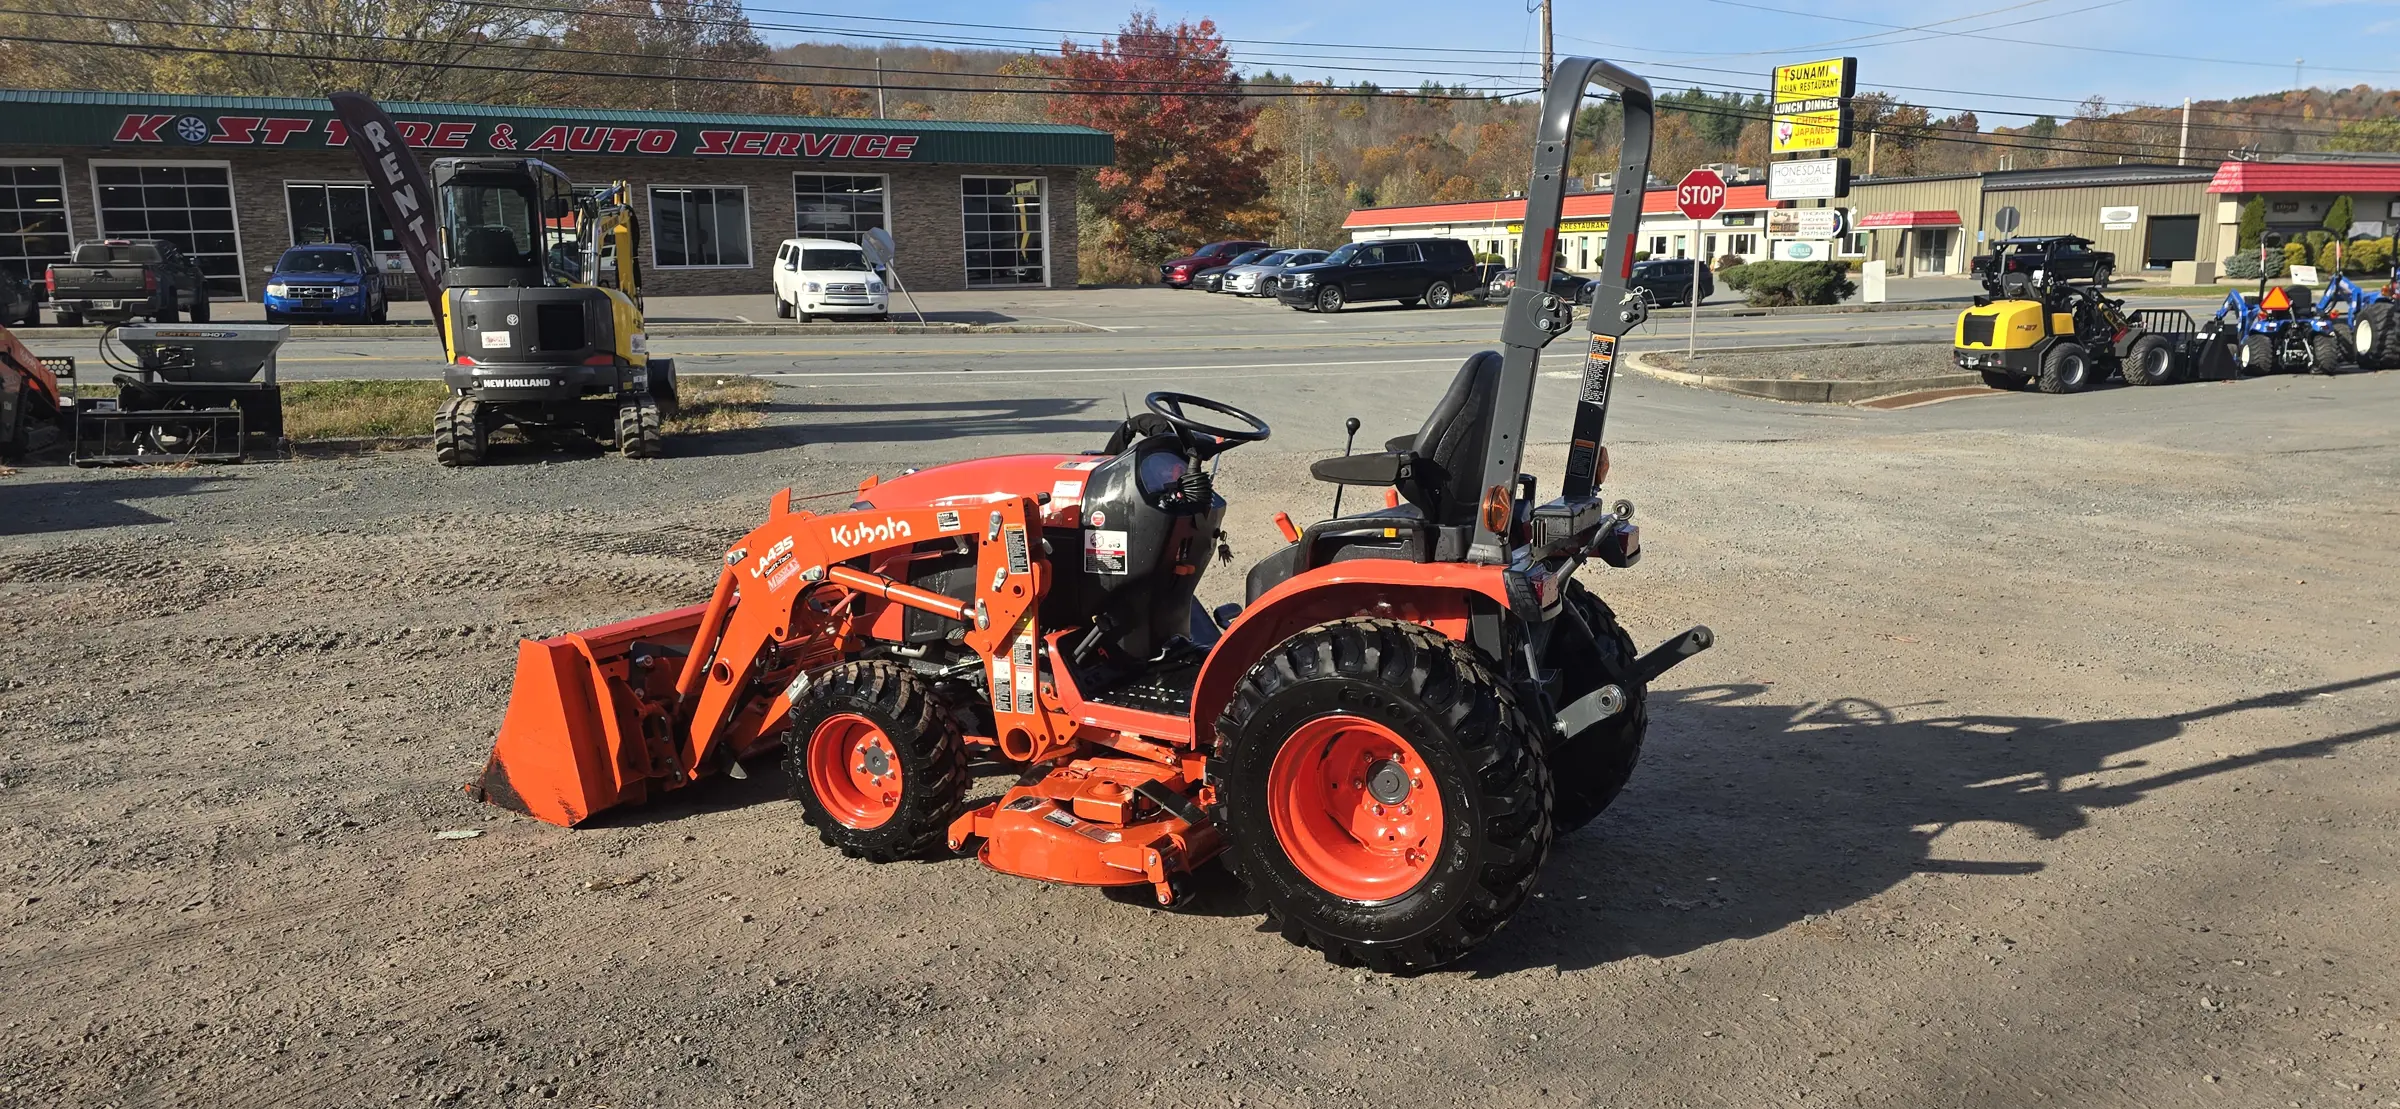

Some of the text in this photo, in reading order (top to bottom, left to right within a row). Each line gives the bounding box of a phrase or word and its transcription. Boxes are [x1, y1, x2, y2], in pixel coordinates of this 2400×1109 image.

[1784, 65, 1829, 82] TSUNAMI
[1780, 78, 1838, 92] ASIAN RESTAURANT
[1774, 98, 1839, 114] LUNCH DINNER
[1796, 114, 1835, 125] CHINESE
[1795, 126, 1835, 136] JAPANESE
[324, 119, 476, 148] TRE
[488, 123, 517, 150] &
[526, 125, 678, 153] AUTO
[693, 130, 919, 160] SERVICE
[1804, 138, 1824, 146] THAI
[1775, 164, 1832, 177] HONESDALE
[1680, 185, 1723, 206] STOP
[363, 120, 444, 291] RENTA
[1565, 221, 1609, 230] RESTAURANT
[483, 379, 551, 387] NEW HOLLAND
[830, 516, 912, 547] Kubota
[750, 535, 794, 579] LA435
